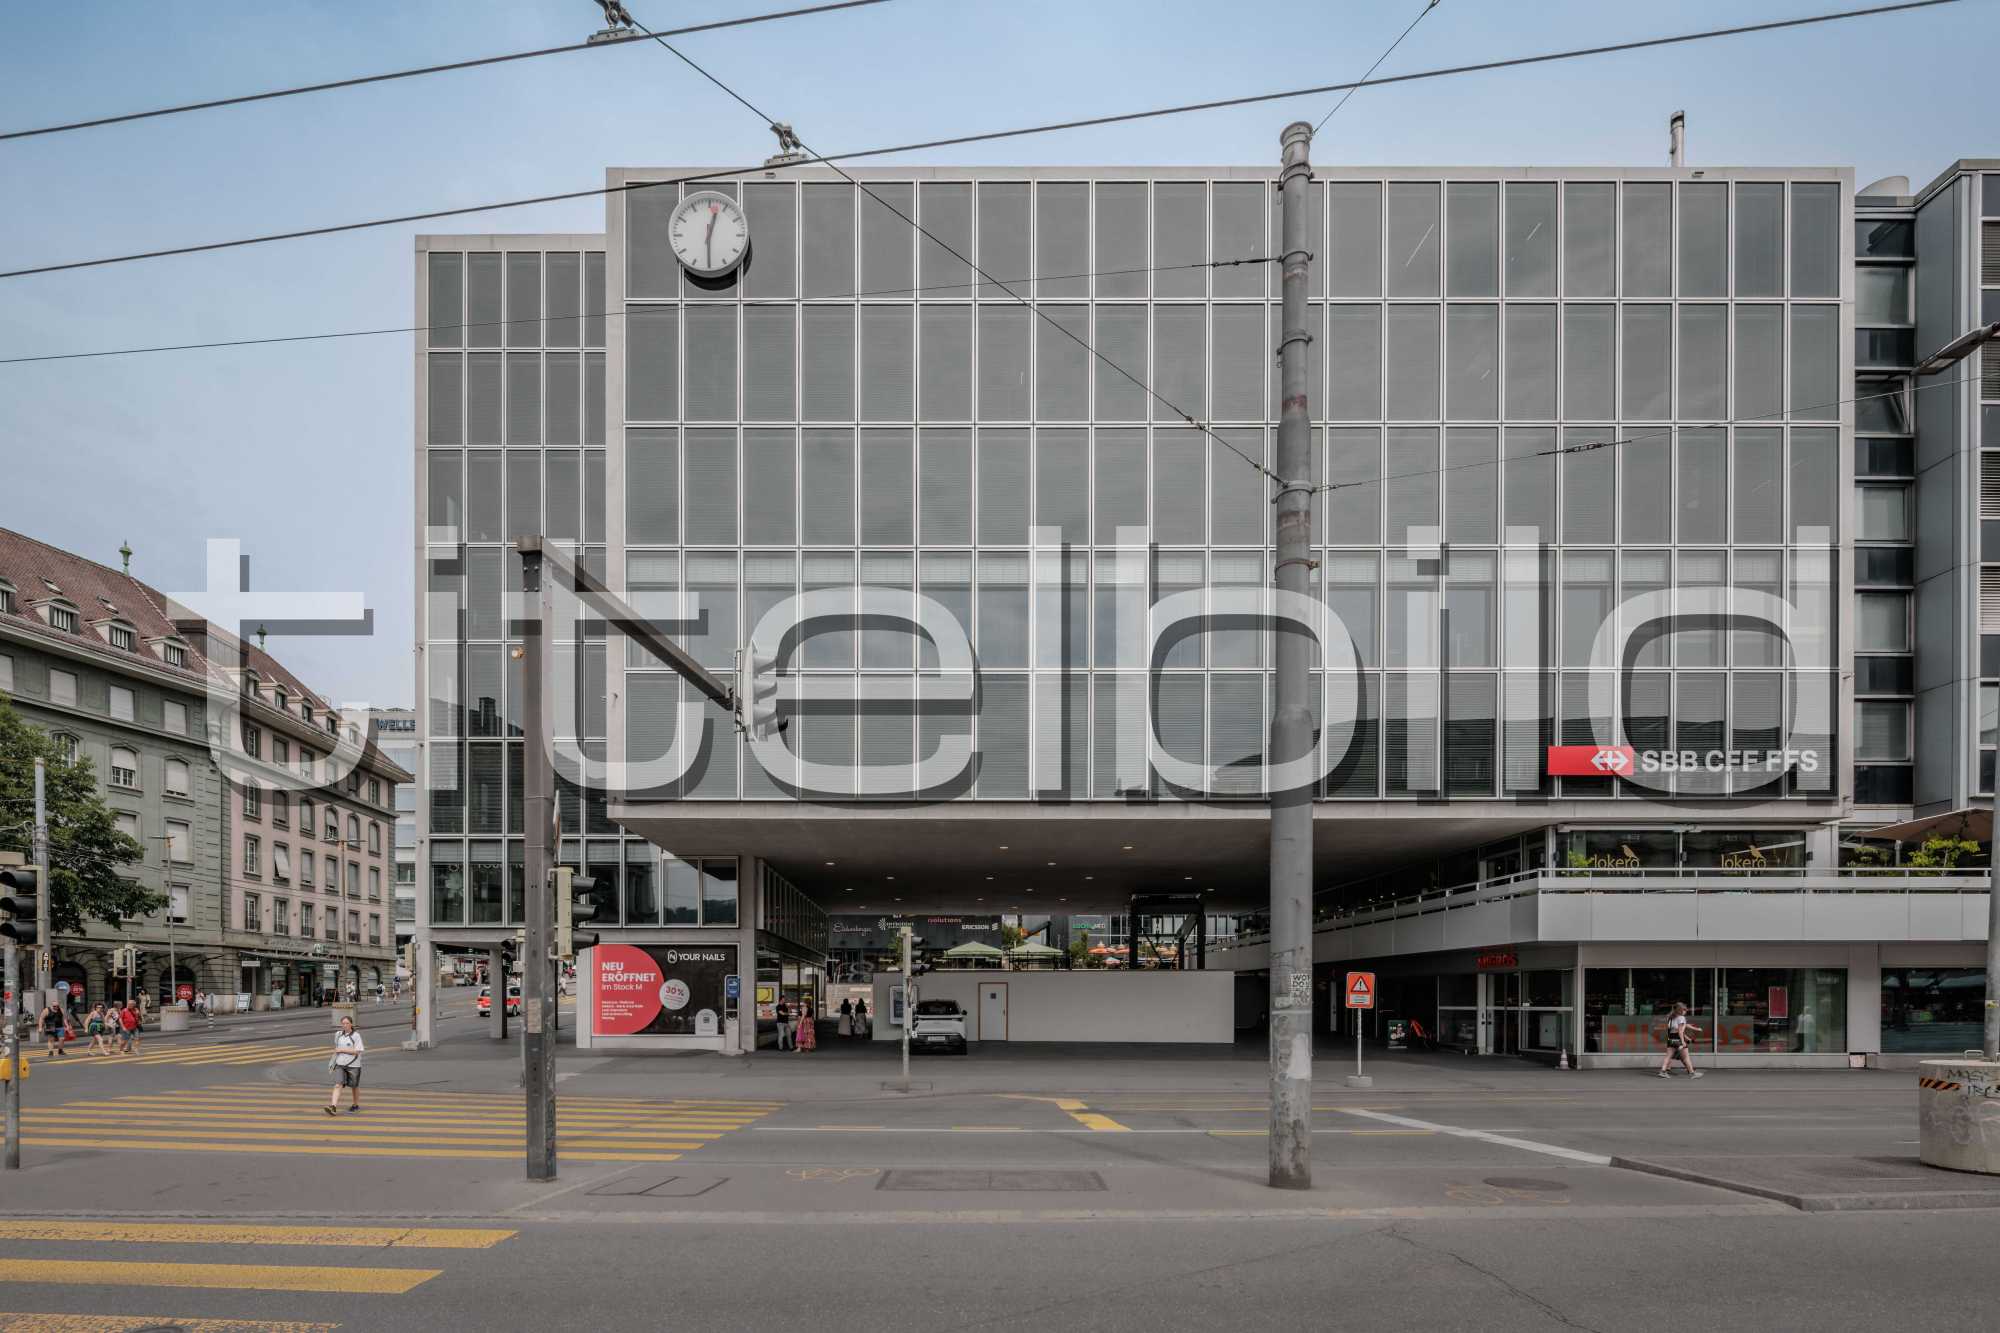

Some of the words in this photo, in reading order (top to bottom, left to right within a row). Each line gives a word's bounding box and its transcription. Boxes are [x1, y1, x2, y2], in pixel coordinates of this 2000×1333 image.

[1641, 750, 1698, 772] SBB
[1705, 750, 1759, 772] CFF
[1766, 750, 1818, 772] FFS
[678, 953, 701, 961] YOUR
[702, 953, 726, 961] NAILS
[601, 962, 624, 971] NEU
[601, 970, 657, 982] ERÖFFNET
[613, 983, 634, 991] Stock
[1606, 1023, 1755, 1049] MIGOS
